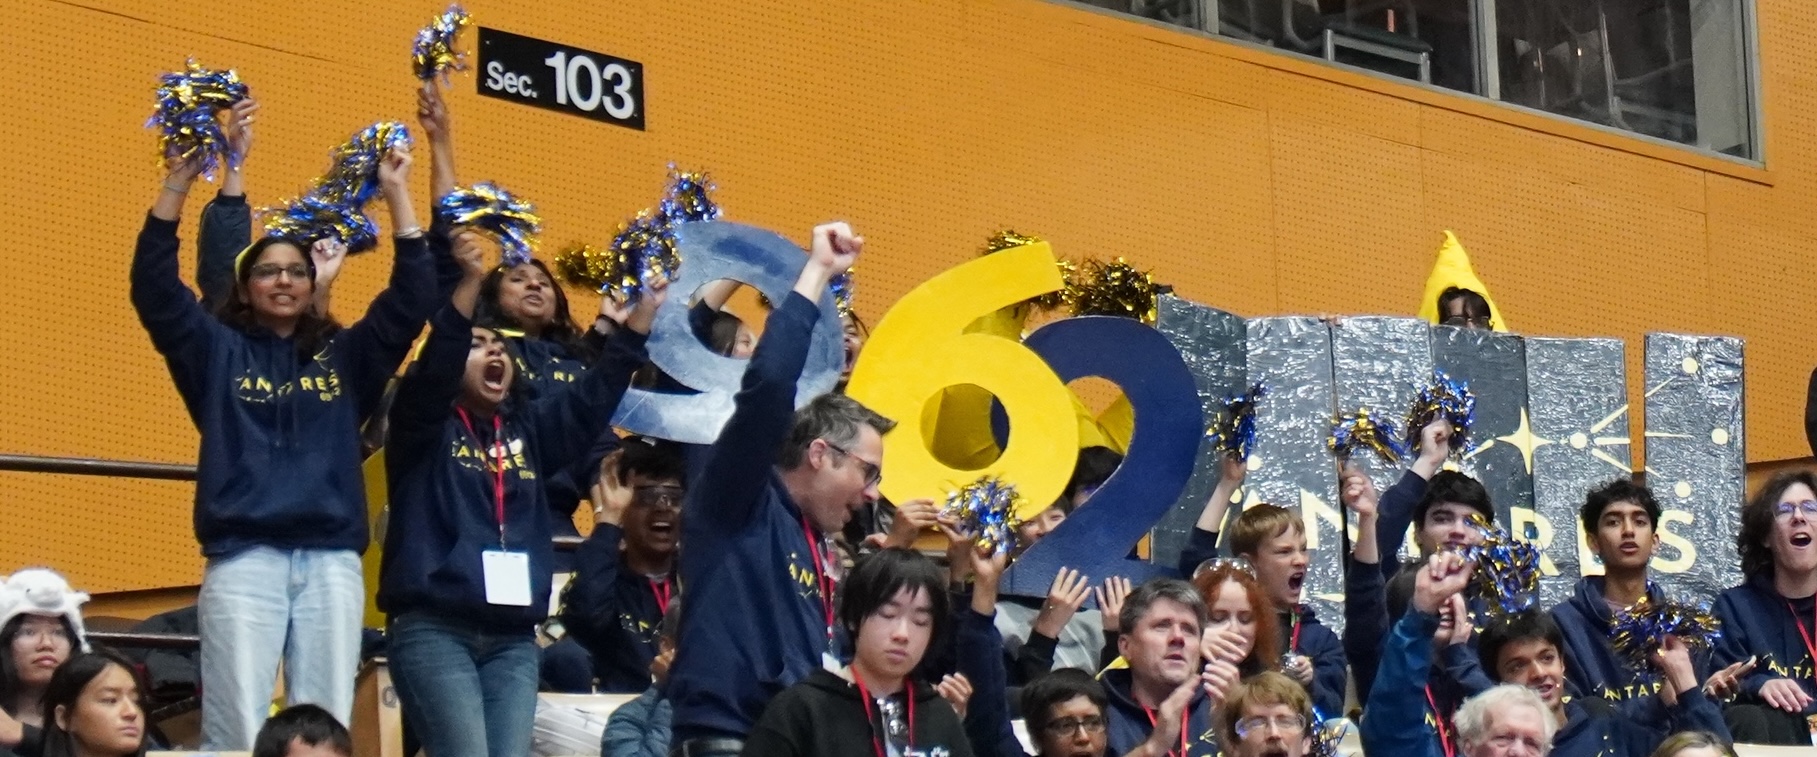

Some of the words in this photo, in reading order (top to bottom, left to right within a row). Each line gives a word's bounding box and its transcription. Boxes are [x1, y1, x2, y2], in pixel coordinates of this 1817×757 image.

[486, 60, 538, 98] Sec.
[544, 51, 635, 120] 103
[239, 373, 339, 397] ANRES
[1215, 488, 1698, 577] ANRS
